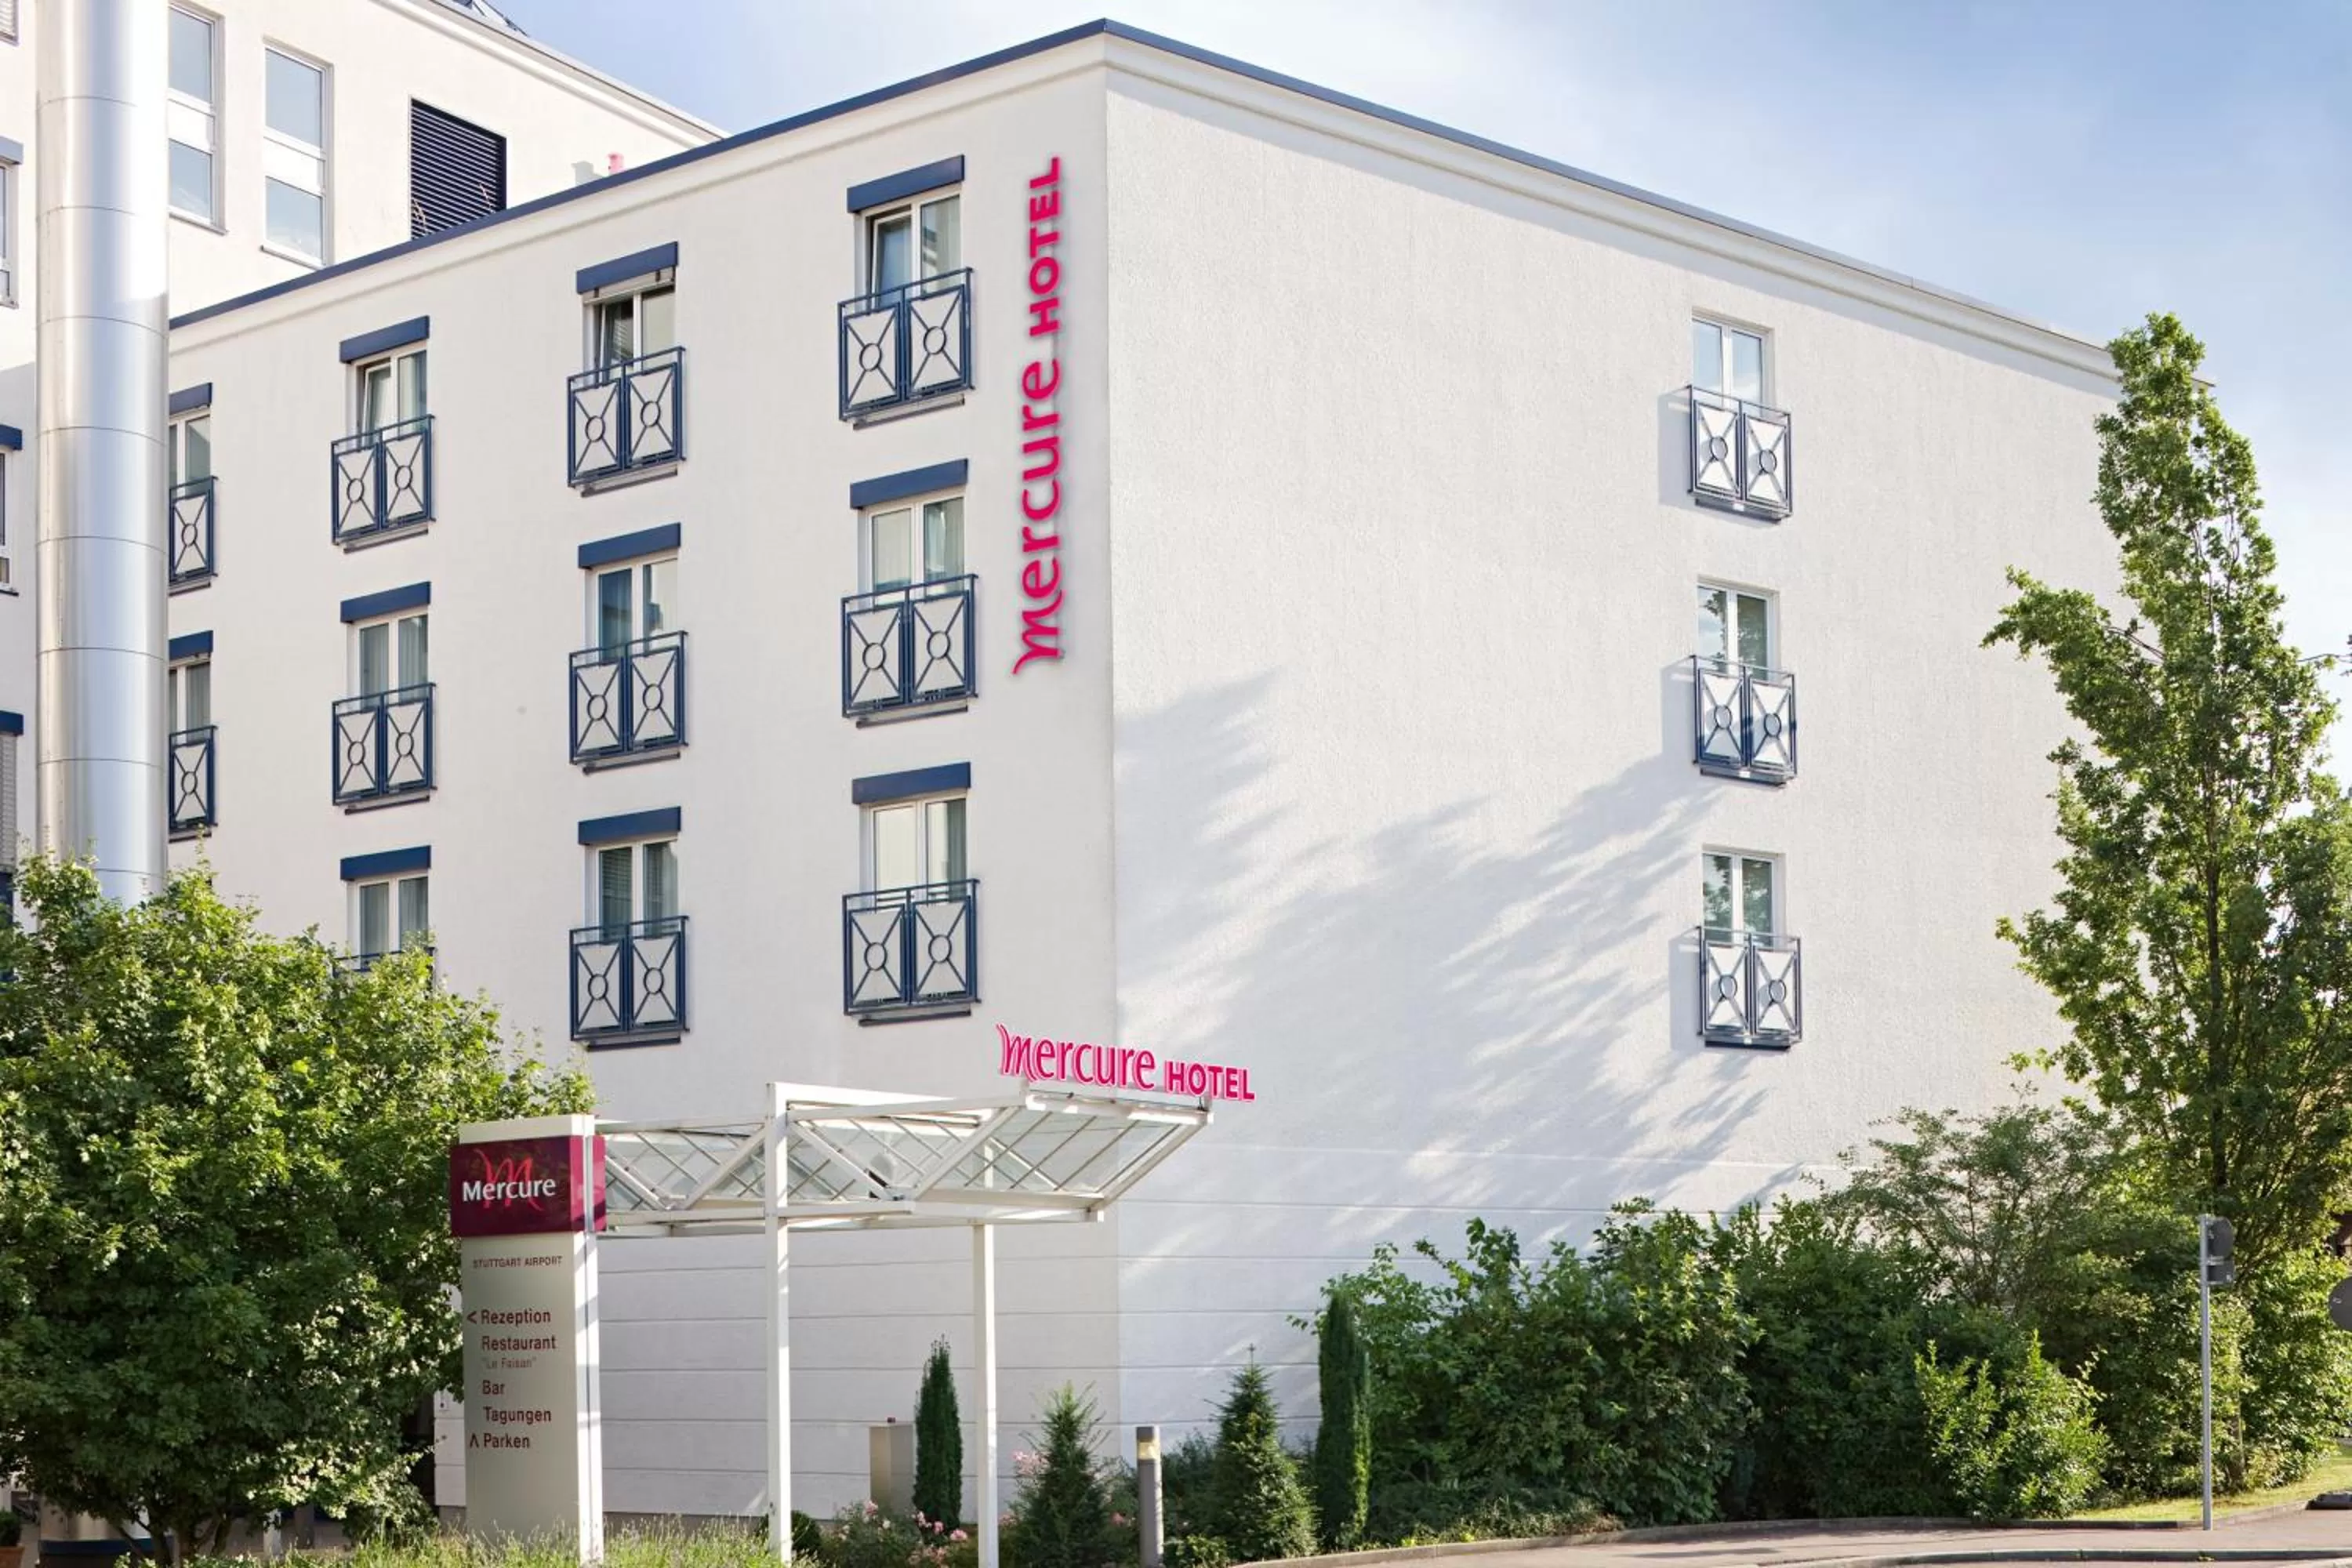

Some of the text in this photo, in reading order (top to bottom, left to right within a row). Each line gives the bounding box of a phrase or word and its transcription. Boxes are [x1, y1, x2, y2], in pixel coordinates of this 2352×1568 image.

[1012, 156, 1064, 675] Mercure HOTEL
[996, 1023, 1255, 1101] Mercure HOTEL
[463, 1178, 556, 1202] Mercure
[473, 1255, 562, 1269] STUTTGART AIRPORT
[481, 1308, 551, 1327] Rezeption
[482, 1334, 556, 1350] Restaurant
[482, 1380, 505, 1395] Bar
[483, 1406, 551, 1425] Tagungen
[484, 1432, 531, 1449] Parken
